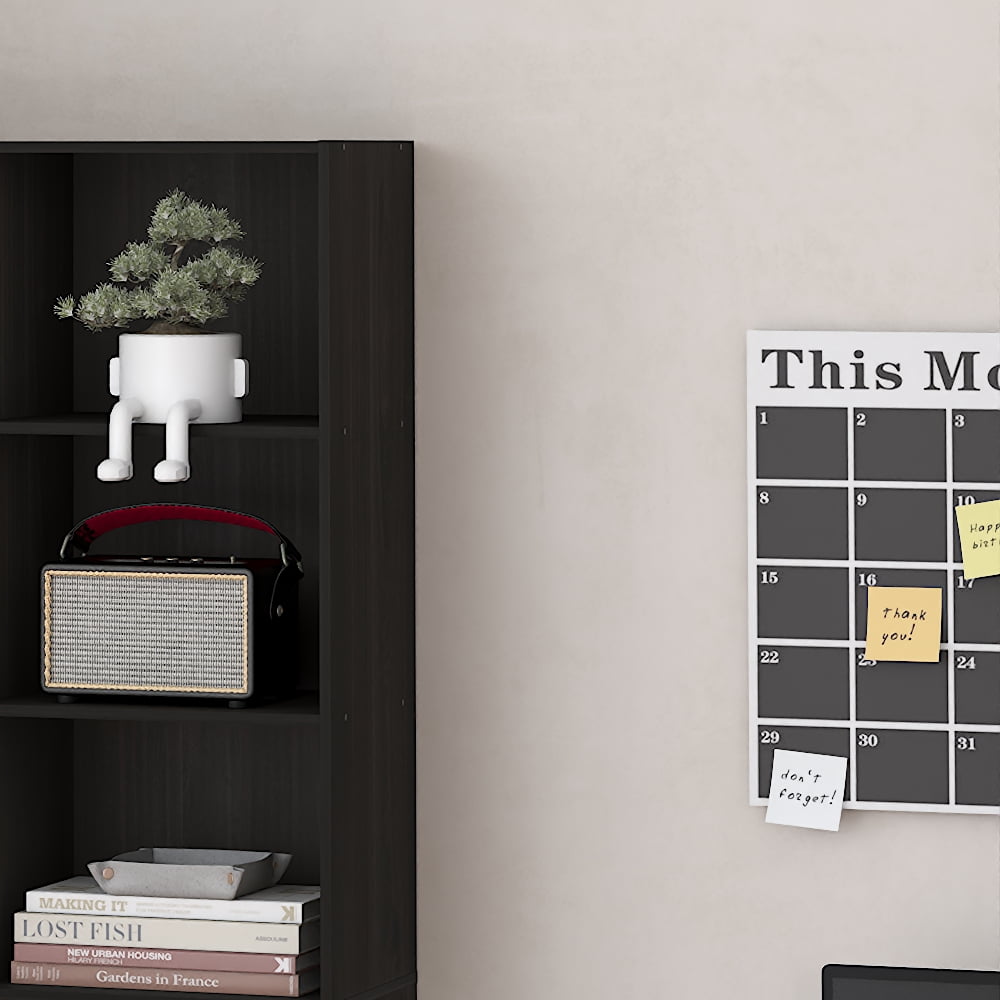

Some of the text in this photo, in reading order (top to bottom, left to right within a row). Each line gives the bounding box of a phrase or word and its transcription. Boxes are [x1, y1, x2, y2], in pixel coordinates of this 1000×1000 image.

[761, 349, 903, 390] This
[760, 412, 768, 425] 1
[856, 413, 866, 426] 2
[954, 414, 965, 428] 3
[759, 492, 770, 504] 8
[856, 494, 867, 506] 9
[957, 496, 976, 506] 10
[760, 571, 778, 584] 15
[858, 573, 877, 586] 16
[881, 624, 916, 645] you!
[760, 651, 780, 664] 22
[956, 656, 976, 670] 24
[760, 731, 780, 744] 29
[858, 734, 878, 746] 30
[957, 737, 976, 750] 31
[39, 896, 106, 912] MAKING
[110, 900, 128, 912] IT
[22, 918, 143, 942] LOST FISH
[67, 948, 172, 962] NEW URBAN HOUSING
[67, 956, 123, 966] HILARY FRENCH
[96, 970, 220, 988] Gardens in France
